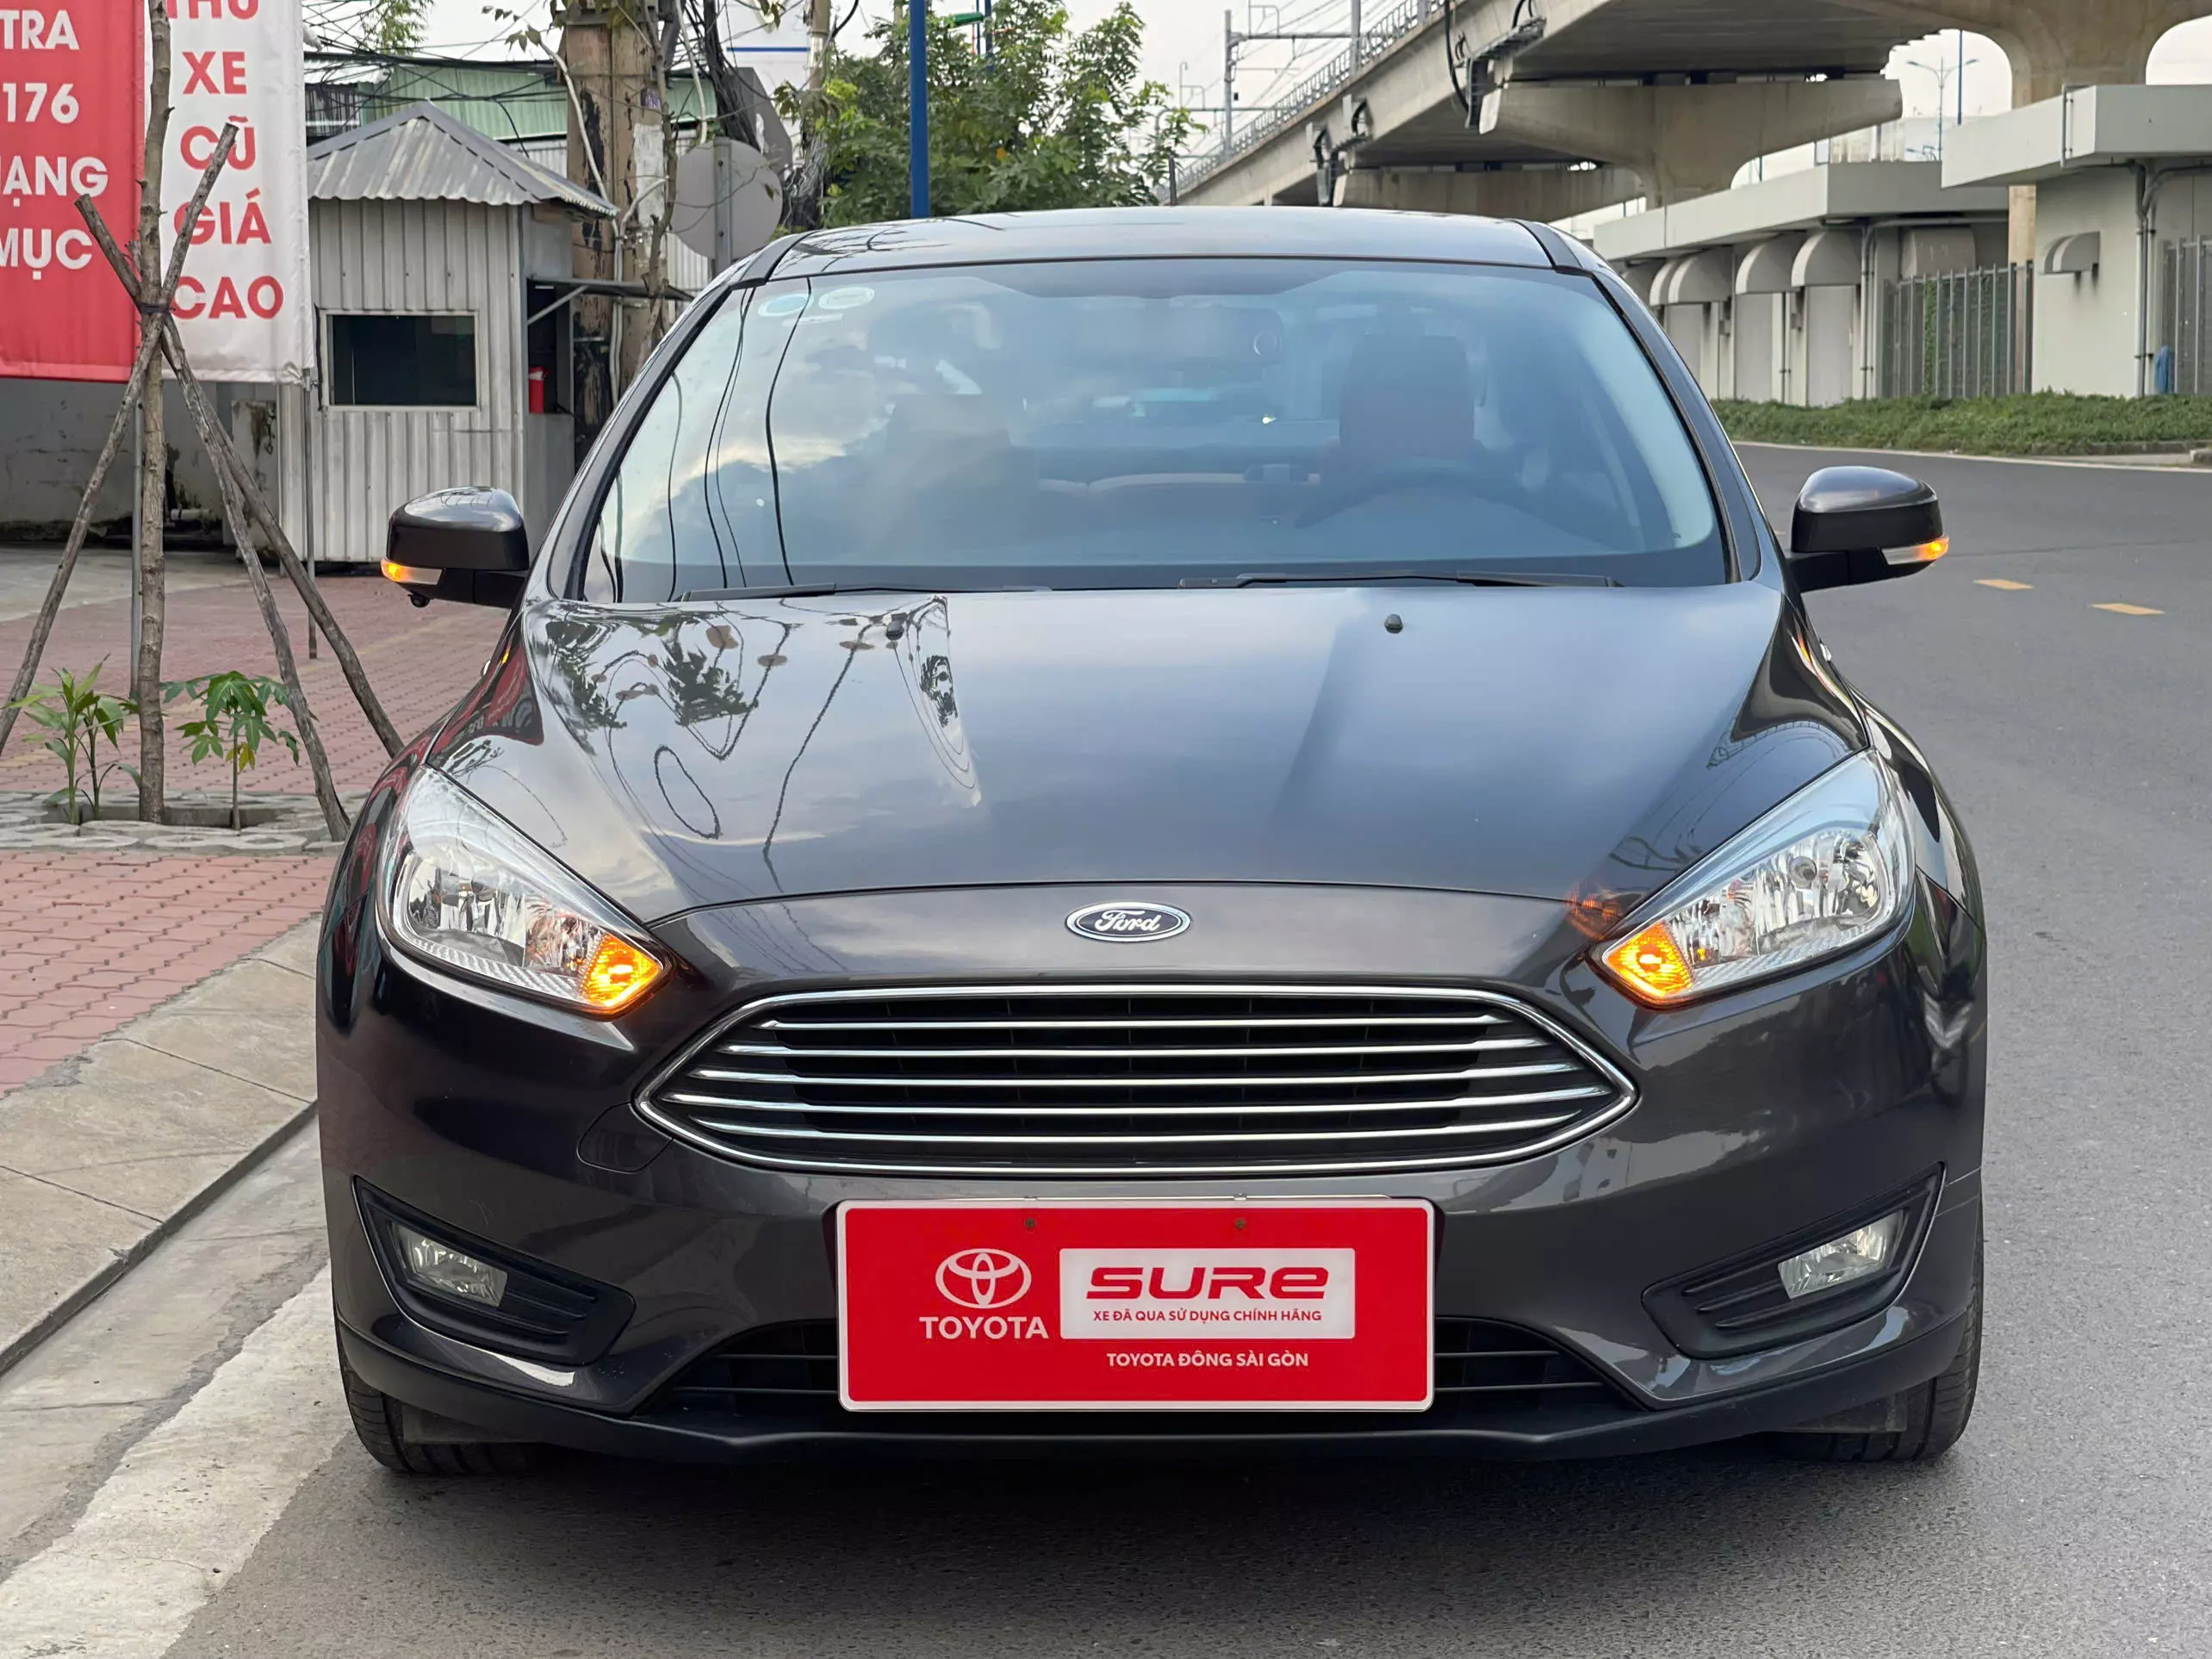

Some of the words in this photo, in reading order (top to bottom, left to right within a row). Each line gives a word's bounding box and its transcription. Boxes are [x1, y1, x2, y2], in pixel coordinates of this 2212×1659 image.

[0, 9, 79, 50] TRA
[182, 51, 247, 95] XE
[3, 82, 79, 124] 176
[180, 115, 256, 171] CŨ
[0, 155, 108, 207] ẠNG
[174, 187, 271, 245] GIÁ
[171, 276, 283, 320] CAO
[1095, 910, 1162, 932] Ford
[919, 1316, 1049, 1339] TOYOTA
[1093, 1310, 1109, 1321] XE
[1113, 1308, 1132, 1321] ĐÃ
[1135, 1310, 1165, 1321] QUA
[1169, 1307, 1187, 1321] SỬ
[1190, 1310, 1230, 1324] DỤNG
[1233, 1307, 1277, 1321] CHÍNH
[1281, 1307, 1322, 1321] HÃNG
[1106, 1352, 1175, 1367] TOYOTA
[1178, 1349, 1233, 1367] ĐÔNG
[1236, 1349, 1264, 1367] SÀI
[1267, 1349, 1308, 1367] GÒN
